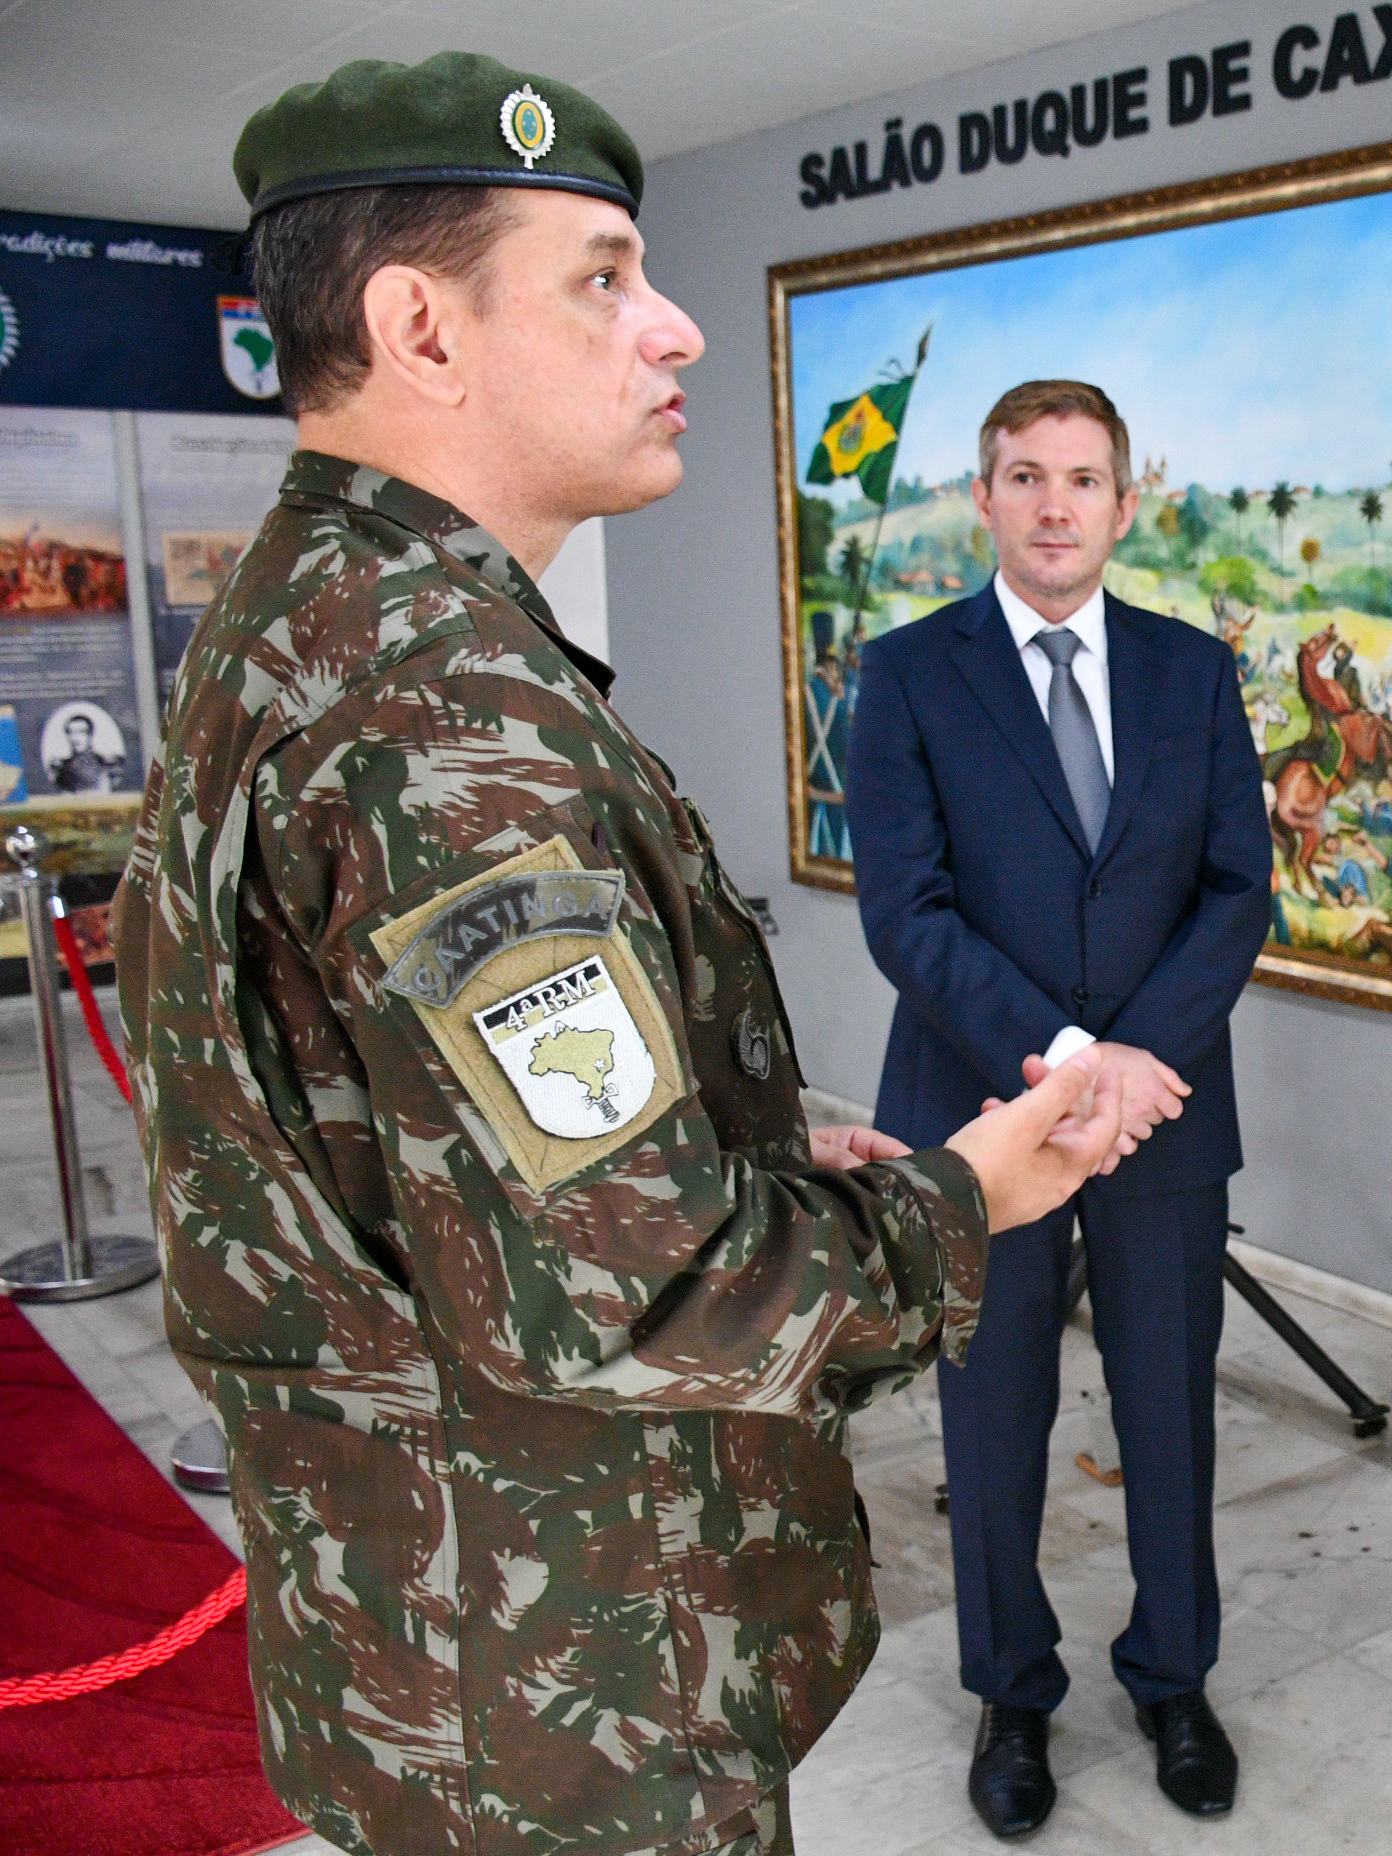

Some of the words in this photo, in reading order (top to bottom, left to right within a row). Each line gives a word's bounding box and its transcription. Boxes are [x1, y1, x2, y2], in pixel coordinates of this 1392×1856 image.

[799, 116, 944, 209] SALÃO
[958, 66, 1149, 174] DUQUE
[1167, 40, 1252, 127] DE
[413, 891, 607, 992] CAATINGA
